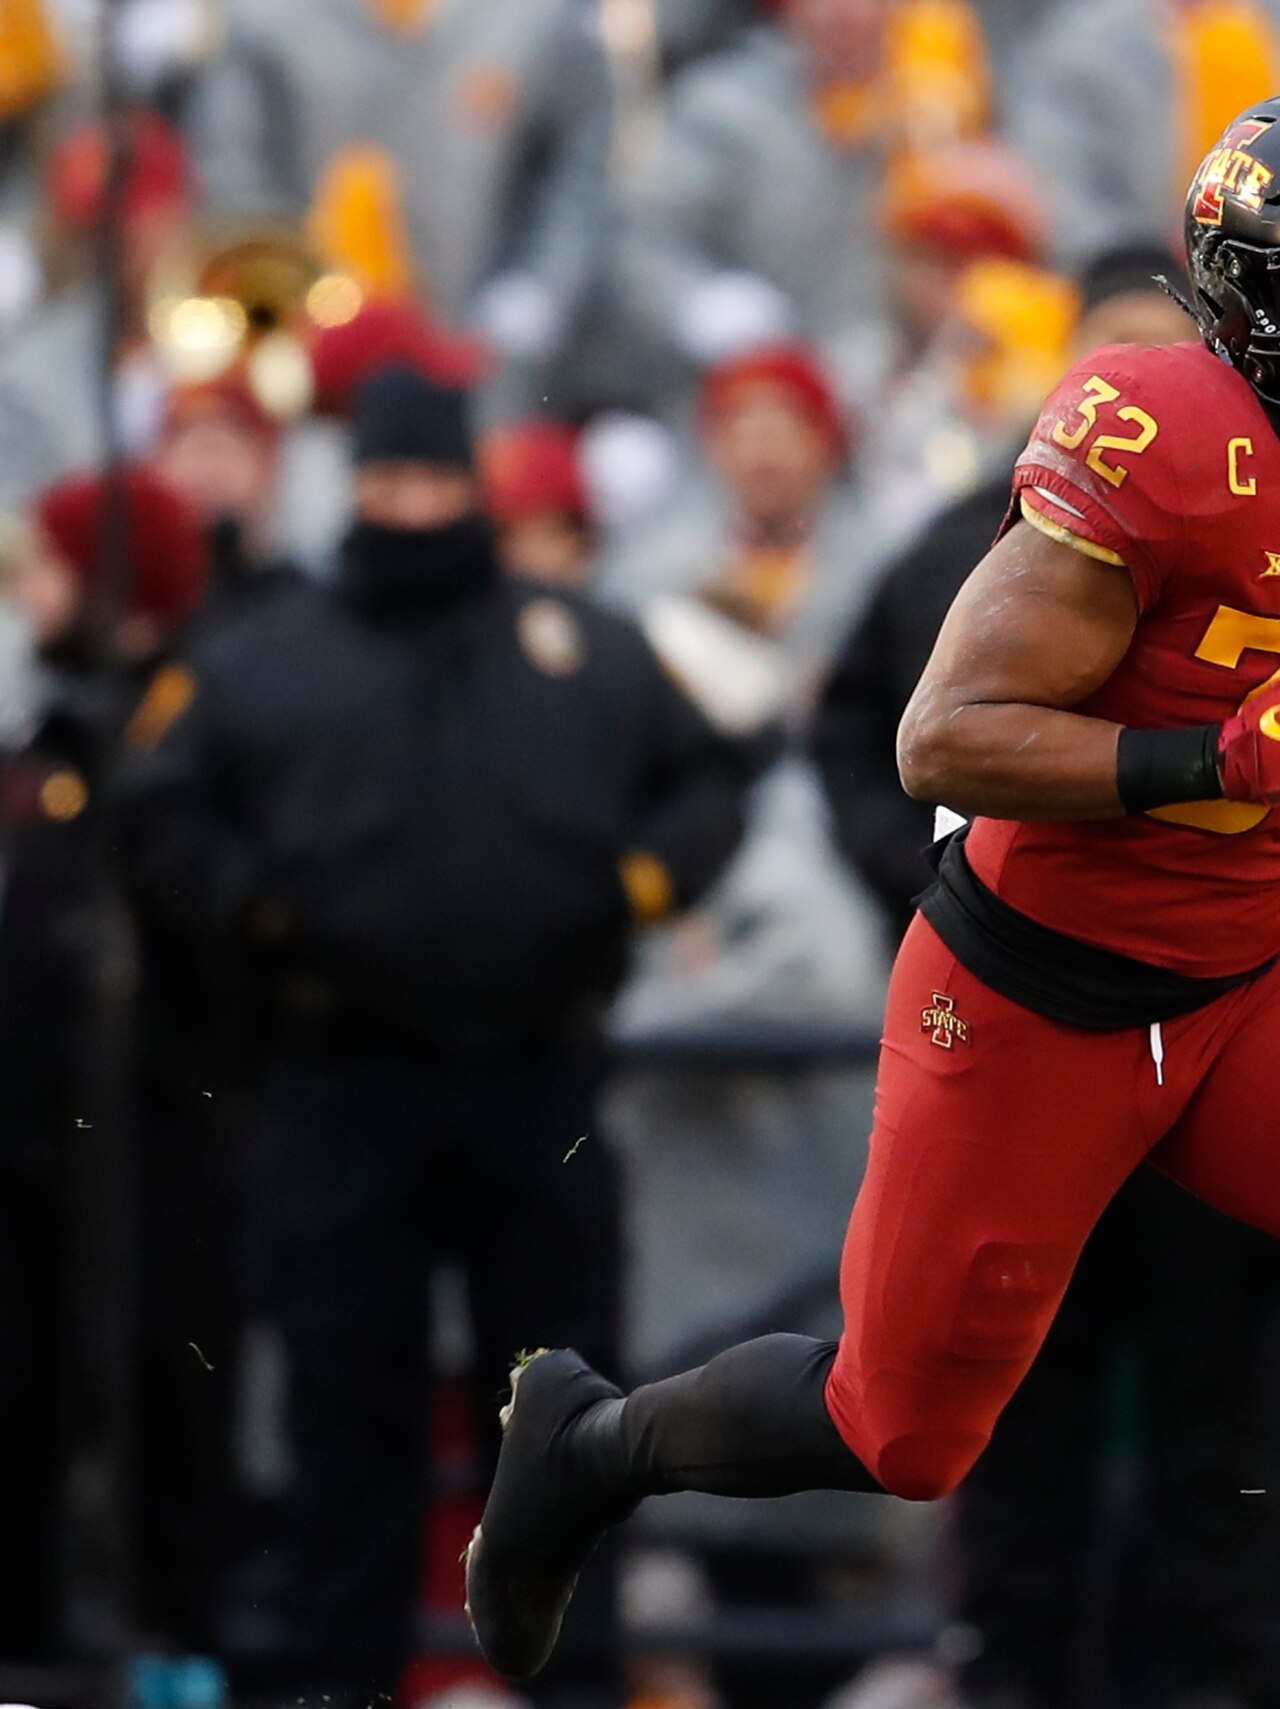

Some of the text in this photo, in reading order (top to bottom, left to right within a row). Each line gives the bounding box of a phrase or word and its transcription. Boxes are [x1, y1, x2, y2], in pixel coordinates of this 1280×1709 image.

[1052, 375, 1158, 488] 32
[1228, 437, 1257, 496] C
[922, 1009, 967, 1041] STATE
